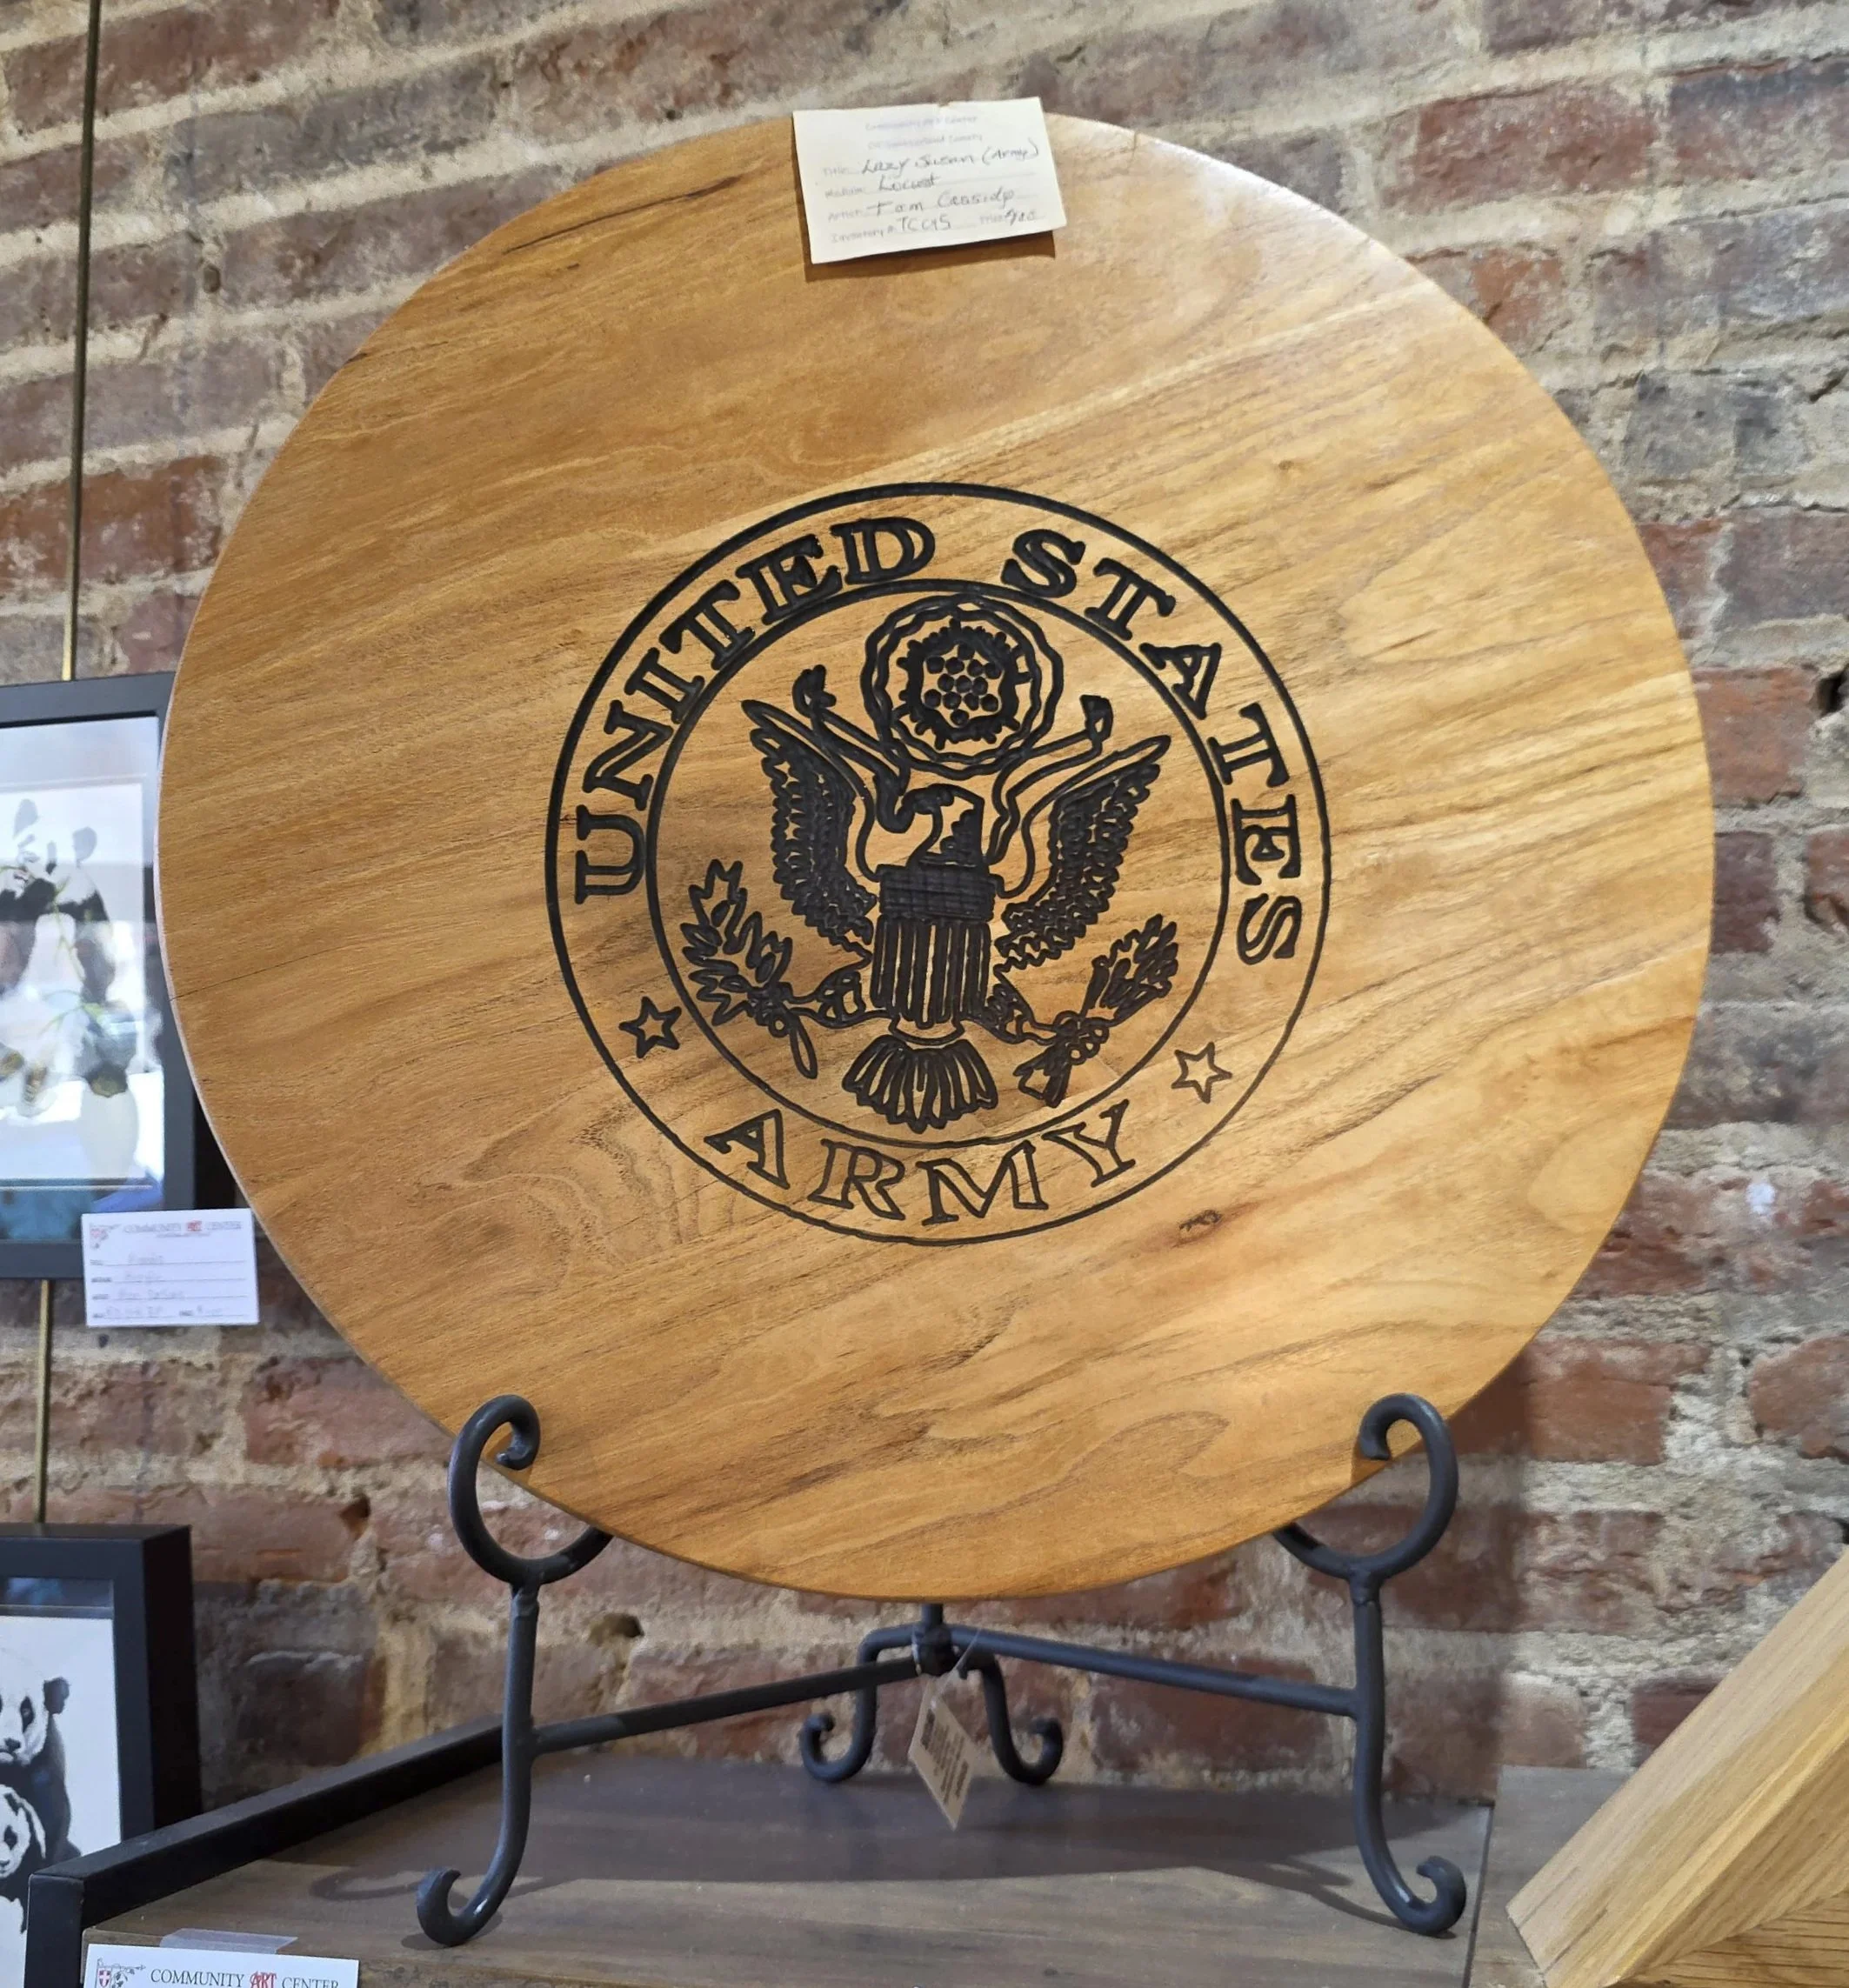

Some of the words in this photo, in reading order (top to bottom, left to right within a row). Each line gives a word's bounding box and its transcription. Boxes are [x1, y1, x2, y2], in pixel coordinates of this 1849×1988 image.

[862, 158, 911, 178] Lazy
[915, 154, 974, 168] Susan
[878, 173, 941, 191] Locust
[866, 201, 924, 217] Tom
[574, 517, 937, 904] UNITED
[1001, 528, 1303, 964] STATES
[705, 1099, 1138, 1225] ARMY
[150, 1968, 245, 1988] COMMUNITY
[250, 1971, 277, 1988] ART
[281, 1977, 339, 1988] CENTER
